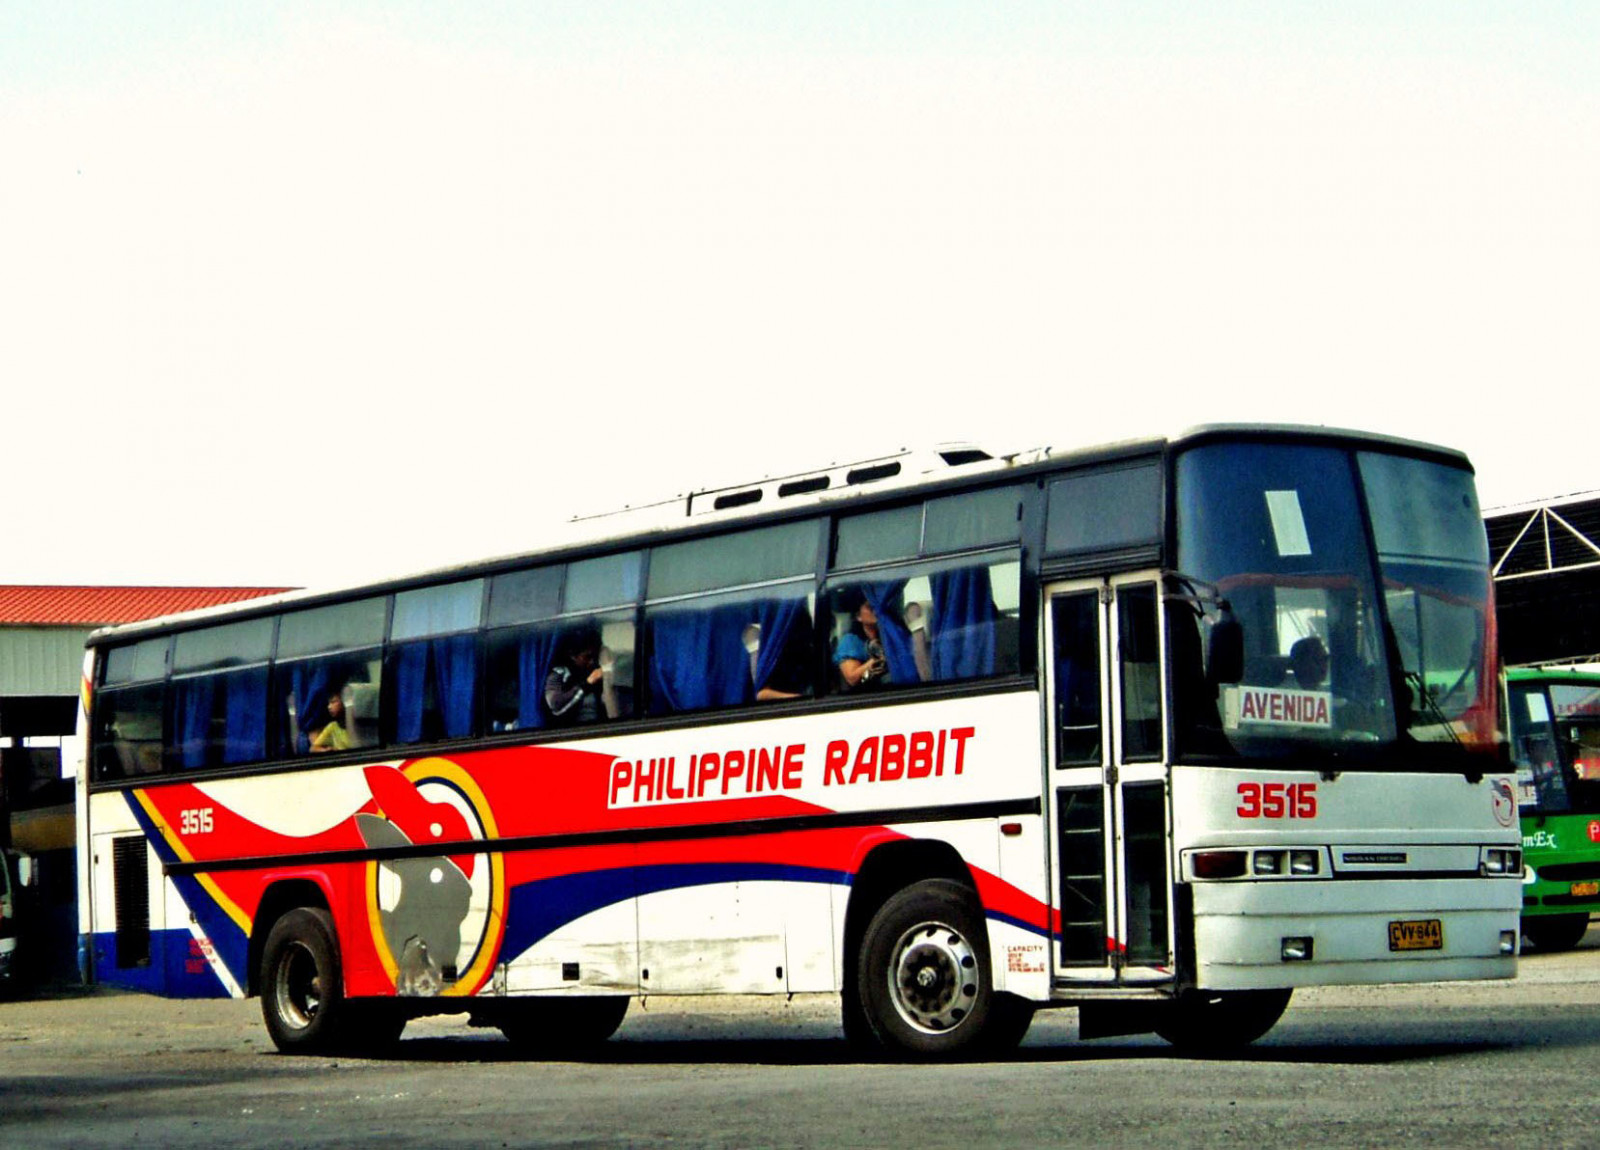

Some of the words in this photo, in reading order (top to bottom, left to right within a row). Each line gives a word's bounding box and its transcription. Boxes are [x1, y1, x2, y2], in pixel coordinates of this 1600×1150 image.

[1241, 691, 1329, 724] AVENIDA
[610, 743, 806, 804] PHILIPPINE
[823, 726, 975, 786] RABBIT
[1236, 782, 1317, 818] 3515
[180, 807, 214, 835] 3515
